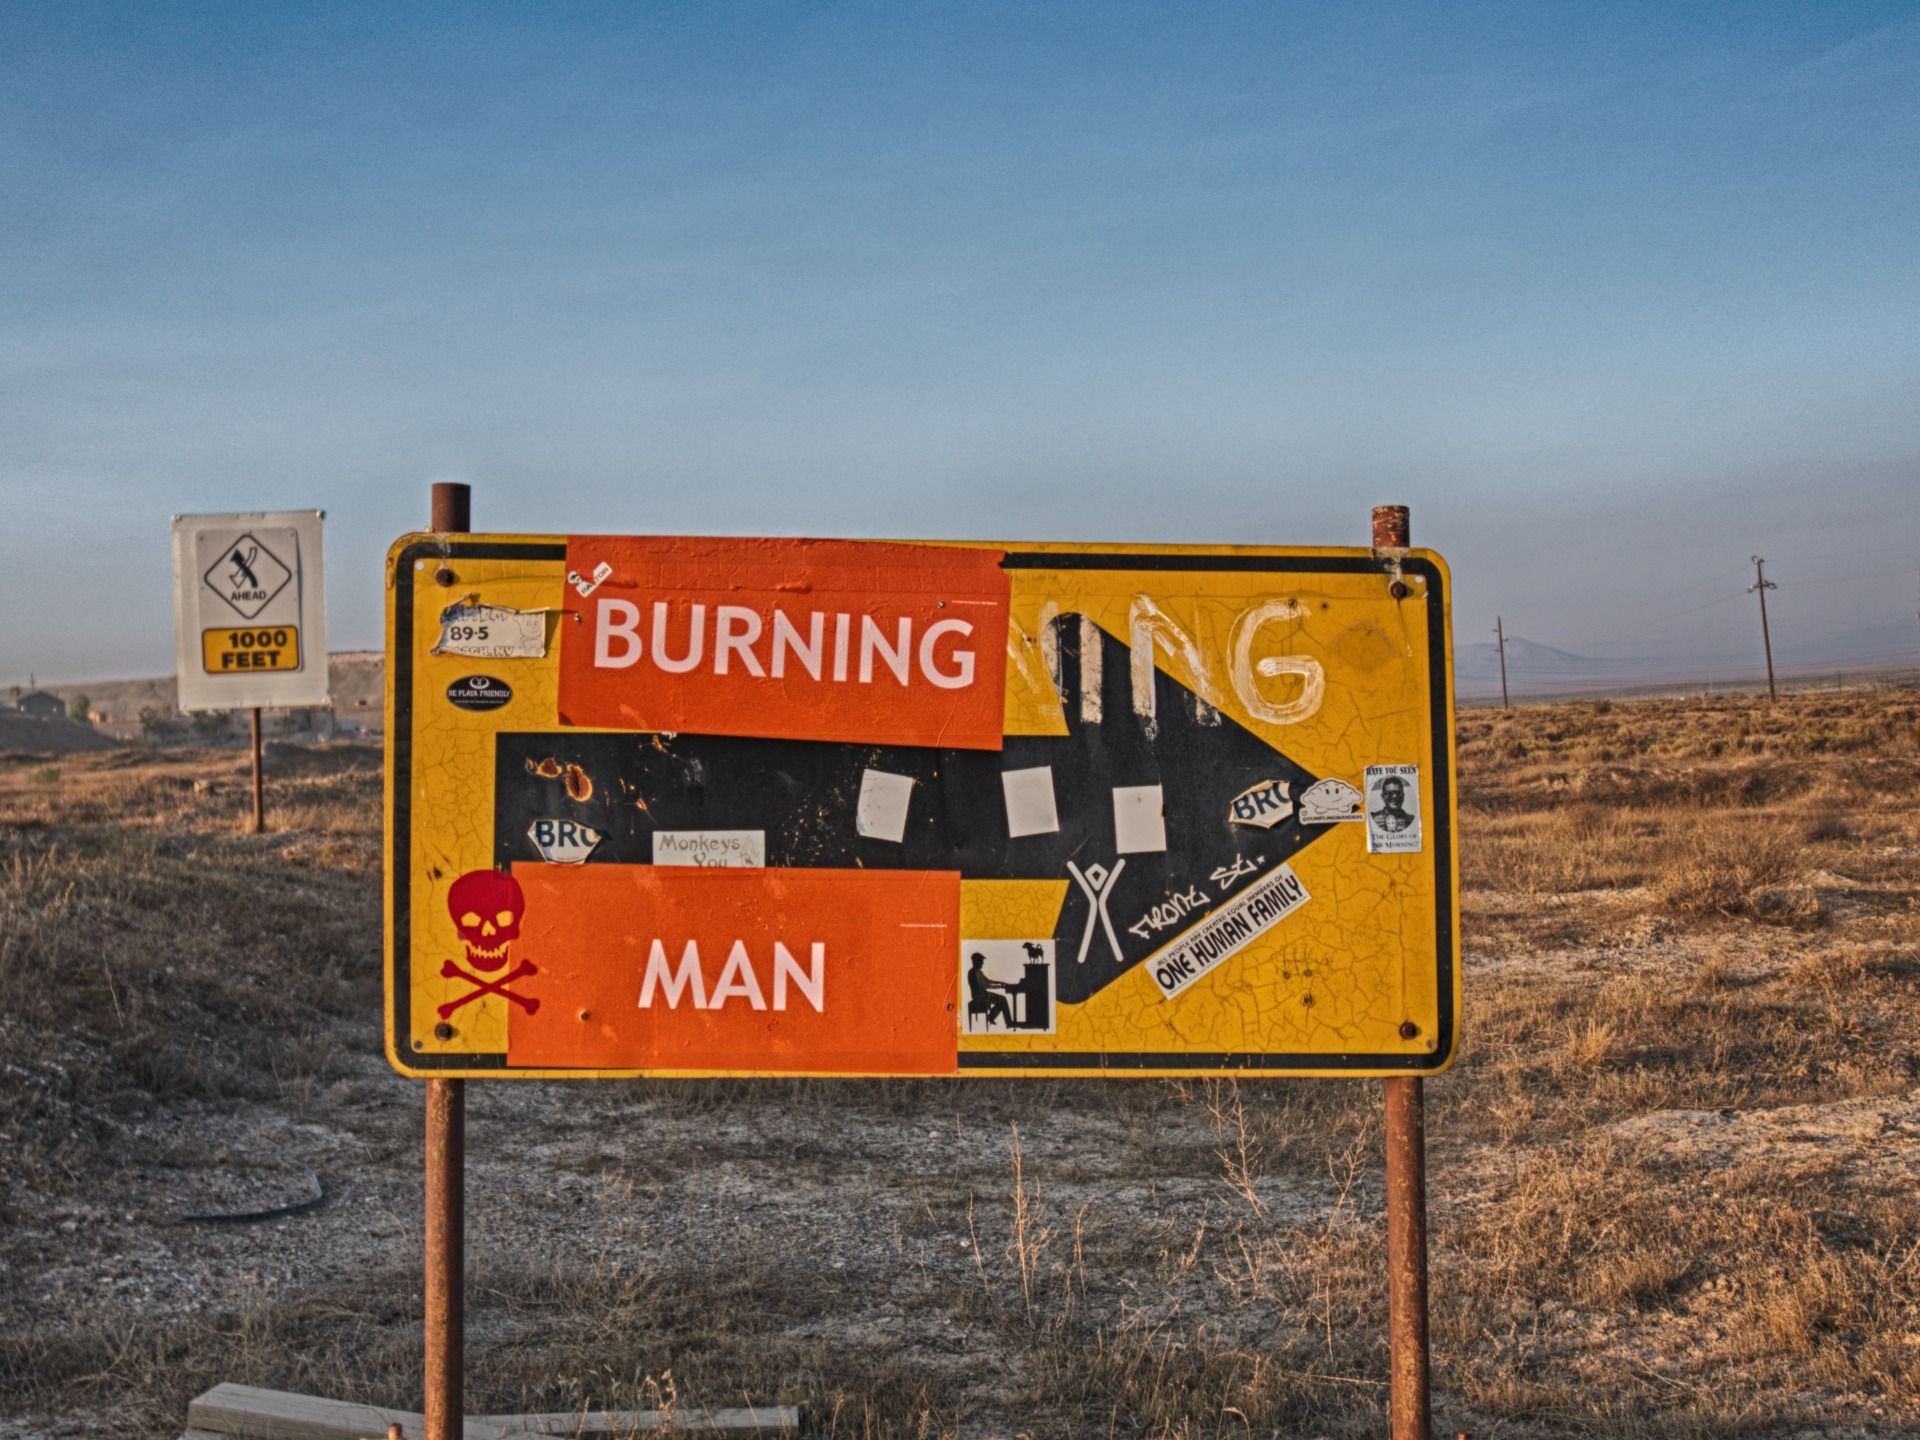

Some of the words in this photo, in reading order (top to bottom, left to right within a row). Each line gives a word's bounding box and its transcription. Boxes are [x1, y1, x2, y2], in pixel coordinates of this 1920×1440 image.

[231, 591, 267, 601] AHEAD
[229, 630, 287, 648] 1000
[594, 598, 976, 688] BURNING
[222, 651, 281, 669] FEET
[458, 689, 478, 697] PLAYA
[479, 689, 511, 697] FRIENDLY
[660, 834, 741, 855] Monkeys
[1168, 941, 1190, 958] PEOPLE
[1202, 914, 1227, 934] CREATED
[1227, 900, 1247, 916] EQUAL
[1247, 881, 1275, 902] MEMBERS
[1156, 953, 1196, 990] ONE
[1189, 912, 1253, 967] HUMAN
[1247, 874, 1303, 927] FAMILY
[638, 939, 825, 1013] MAN
